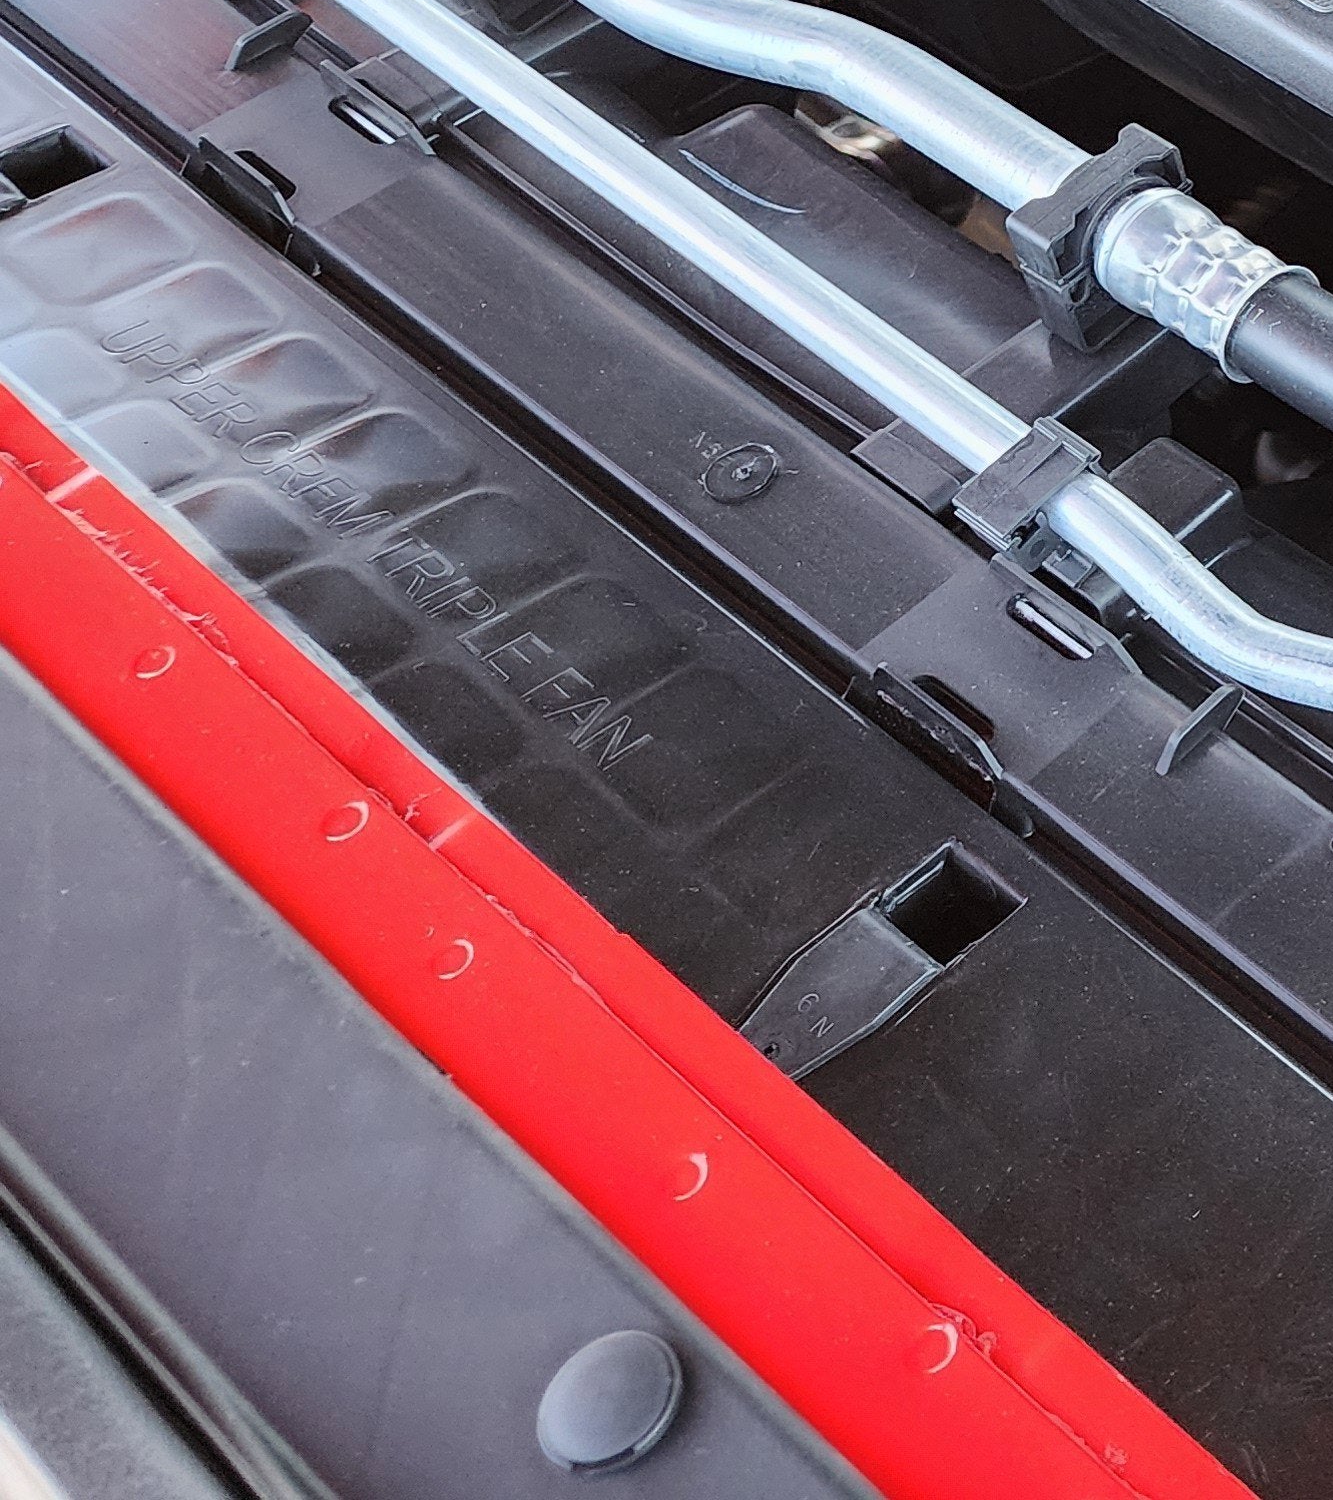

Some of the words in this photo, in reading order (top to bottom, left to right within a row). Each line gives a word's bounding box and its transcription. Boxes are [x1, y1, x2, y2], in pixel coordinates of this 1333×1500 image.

[101, 319, 258, 439] UPPER
[239, 428, 393, 540] CRFM
[366, 527, 555, 683] TRIPLE
[520, 666, 654, 771] FAN
